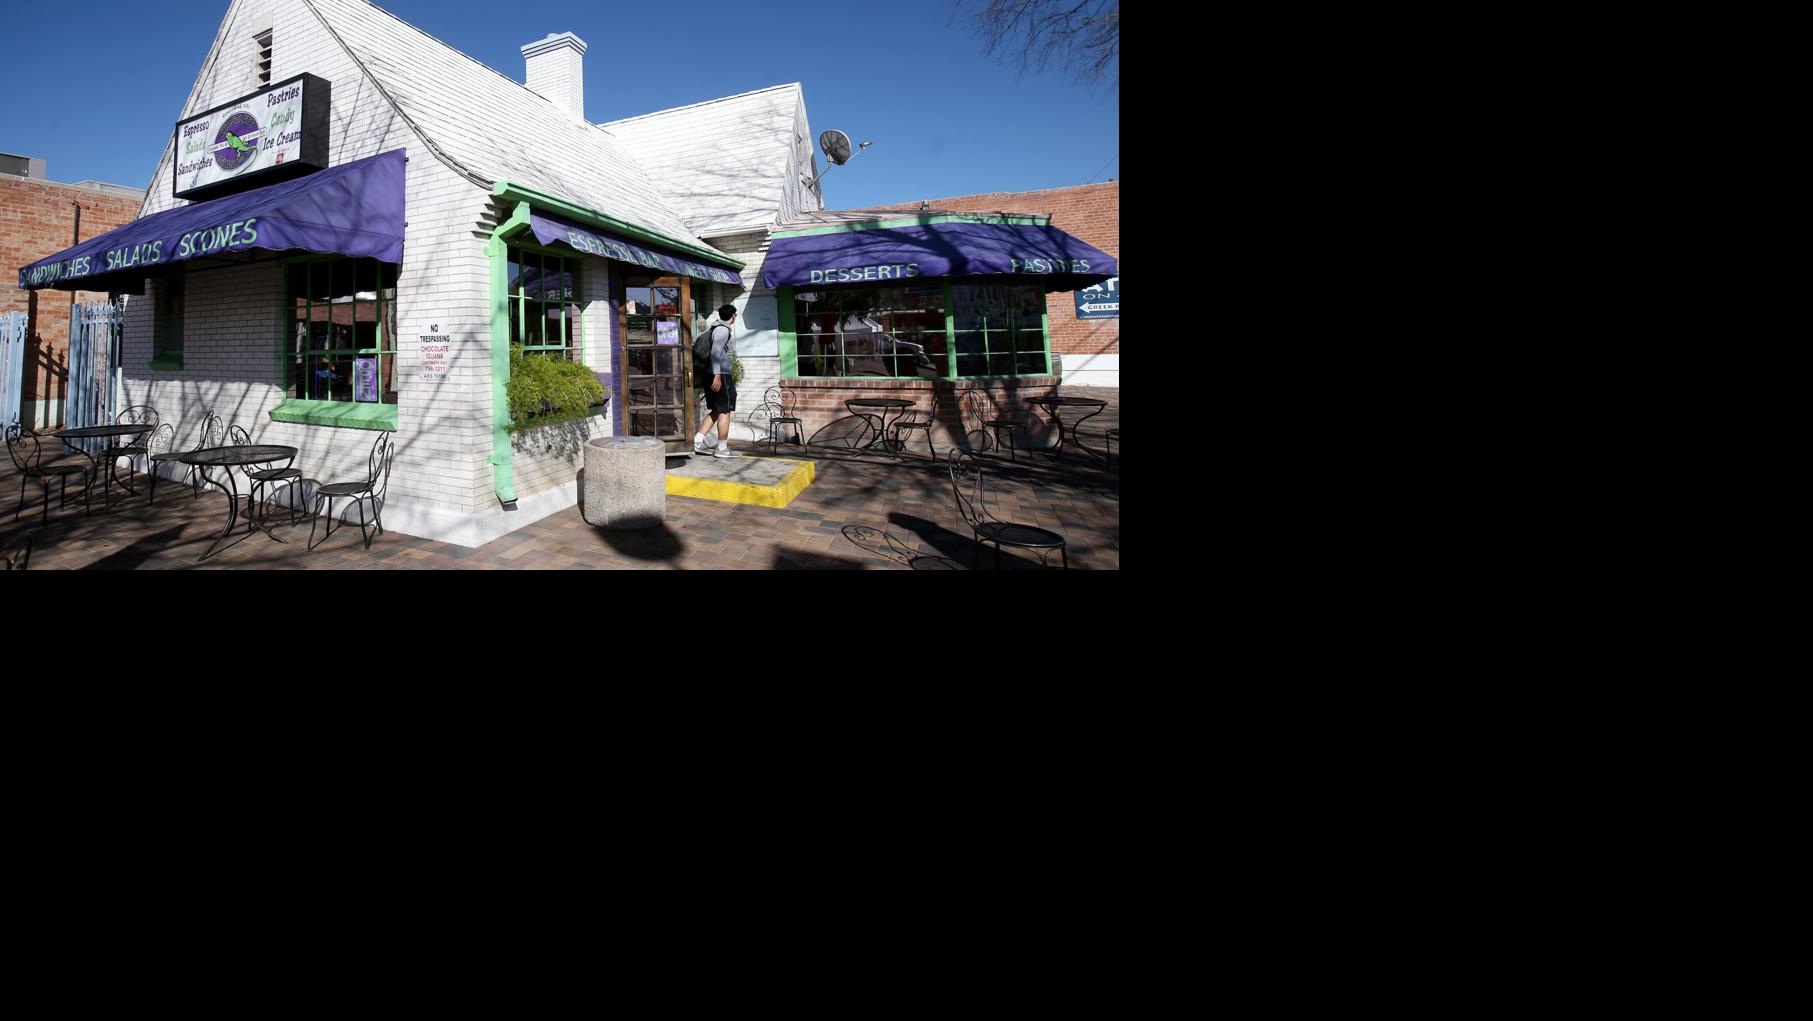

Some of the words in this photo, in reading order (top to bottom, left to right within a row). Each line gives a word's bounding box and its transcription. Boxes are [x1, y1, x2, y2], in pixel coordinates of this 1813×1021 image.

[267, 85, 300, 107] Pastries
[271, 107, 295, 128] Candy
[183, 120, 210, 139] Espresso
[186, 138, 206, 155] Salads
[262, 136, 275, 151] Ice
[276, 129, 301, 147] Cream
[178, 157, 213, 176] Sandwiches
[105, 240, 162, 271] SALADS
[179, 218, 257, 257] SCONES
[810, 263, 920, 283] DESSERTS
[430, 324, 438, 333] NO
[359, 360, 372, 401] OPEN
